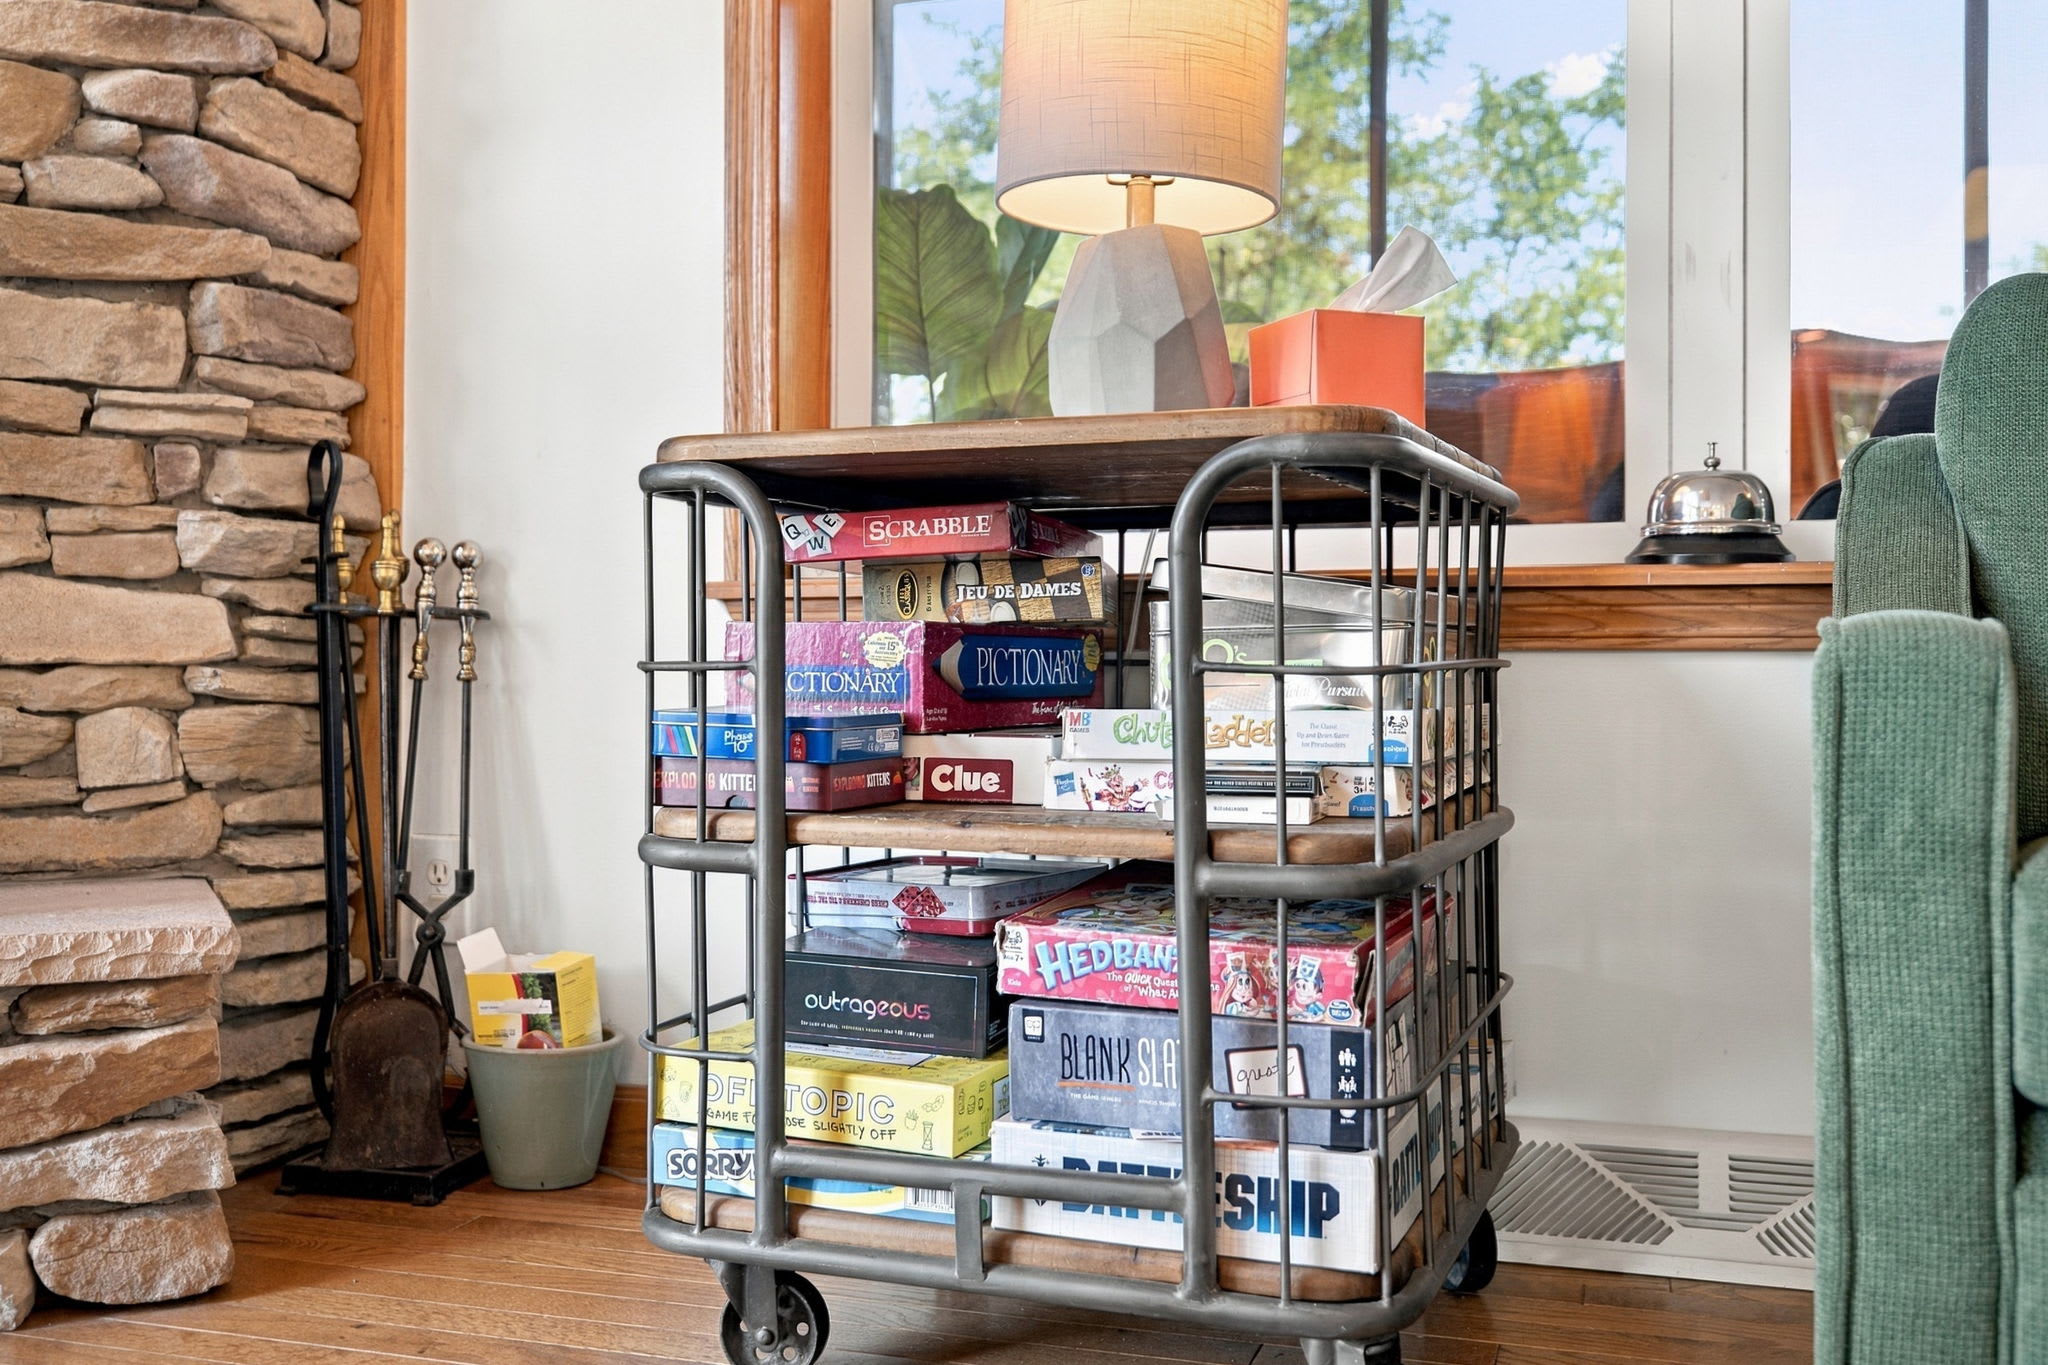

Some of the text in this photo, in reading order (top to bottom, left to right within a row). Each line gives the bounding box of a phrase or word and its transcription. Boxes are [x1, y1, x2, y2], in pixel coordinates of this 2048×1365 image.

[869, 515, 991, 541] SCRABBLE
[956, 582, 1082, 602] JEU DE DAMES
[976, 647, 1081, 686] PICTIONARY
[785, 671, 904, 693] CTIONARY
[1069, 711, 1091, 726] MB
[724, 729, 753, 742] Phase
[733, 741, 748, 753] 10
[720, 772, 756, 791] KITTE
[866, 771, 890, 788] KITTENS
[931, 764, 1000, 792] Clue
[1106, 972, 1122, 982] The
[1125, 972, 1152, 985] QUICK
[805, 991, 932, 1020] outrageous
[1061, 1033, 1180, 1089] BLANK SLA
[785, 1084, 895, 1125] TOPIC
[706, 1108, 738, 1121] GAME
[813, 1121, 865, 1140] SLIGHTLY
[870, 1129, 897, 1140] OFF
